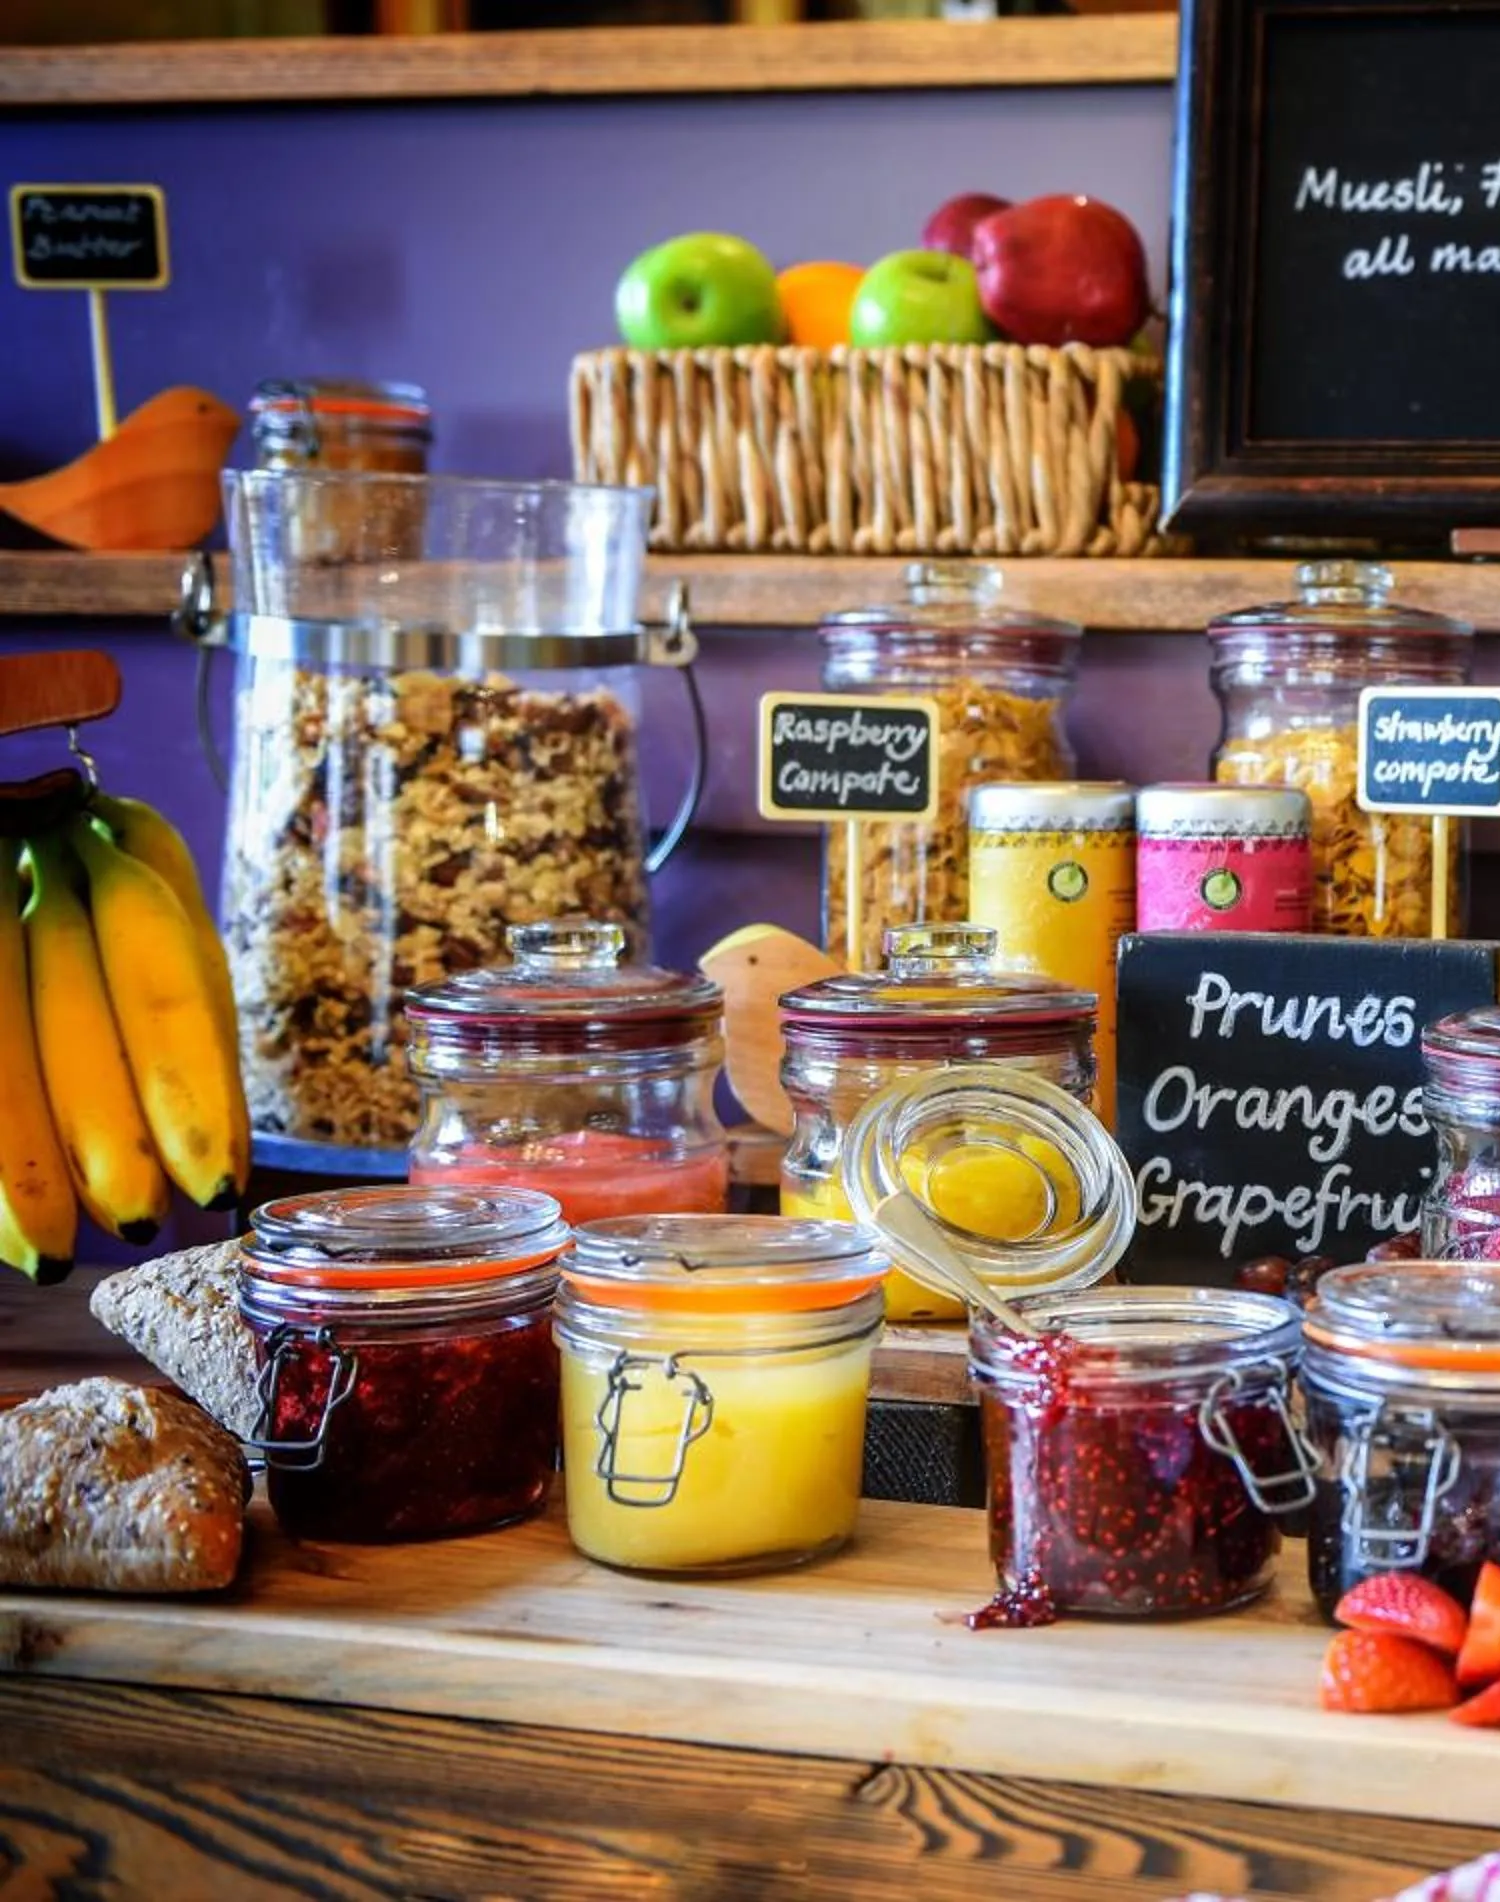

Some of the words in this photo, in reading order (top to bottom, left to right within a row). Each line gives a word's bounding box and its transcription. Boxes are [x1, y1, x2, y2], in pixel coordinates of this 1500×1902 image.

[1343, 234, 1415, 279] all
[773, 710, 930, 762] Raspberry
[1186, 971, 1417, 1048] Prunes
[1143, 1064, 1431, 1162] Oranges
[1136, 1155, 1431, 1259] Grapefru
